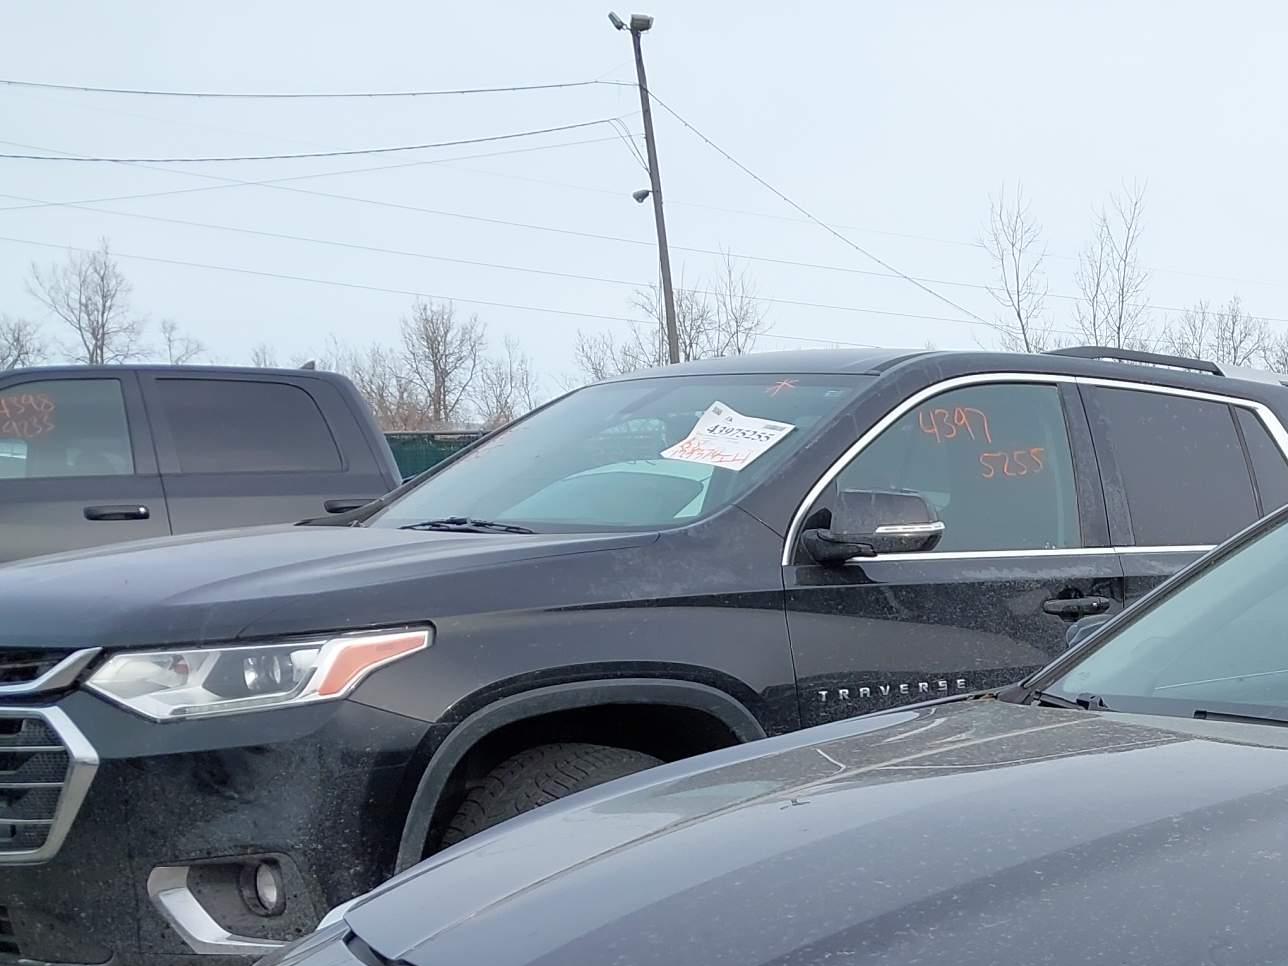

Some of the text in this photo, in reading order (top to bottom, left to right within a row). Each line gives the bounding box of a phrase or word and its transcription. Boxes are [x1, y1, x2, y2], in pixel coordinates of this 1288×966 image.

[919, 407, 992, 443] 4397
[980, 448, 1045, 478] 5255
[818, 679, 966, 701] TRAVERSE
